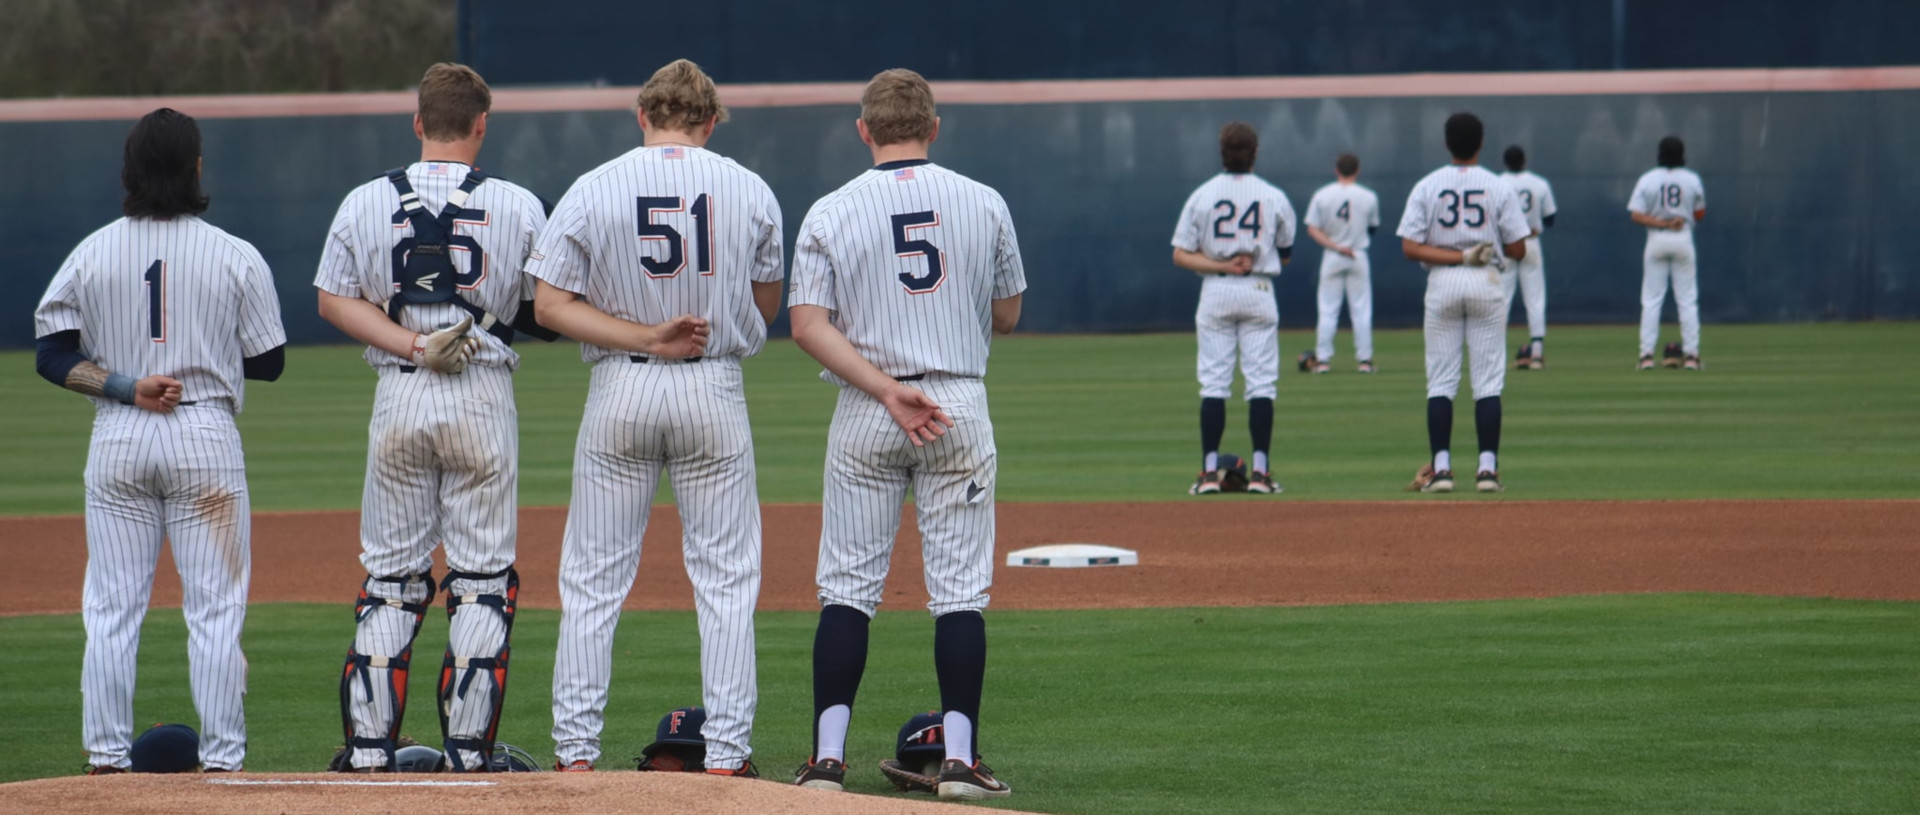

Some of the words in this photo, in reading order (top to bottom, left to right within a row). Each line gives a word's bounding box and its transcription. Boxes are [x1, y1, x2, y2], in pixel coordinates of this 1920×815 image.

[1336, 199, 1351, 223] 4
[1438, 189, 1487, 230] 35
[1660, 183, 1682, 208] 18
[636, 193, 714, 279] 51
[1213, 199, 1263, 241] 24
[890, 210, 947, 295] 5
[144, 259, 167, 343] 1
[669, 711, 686, 734] F
